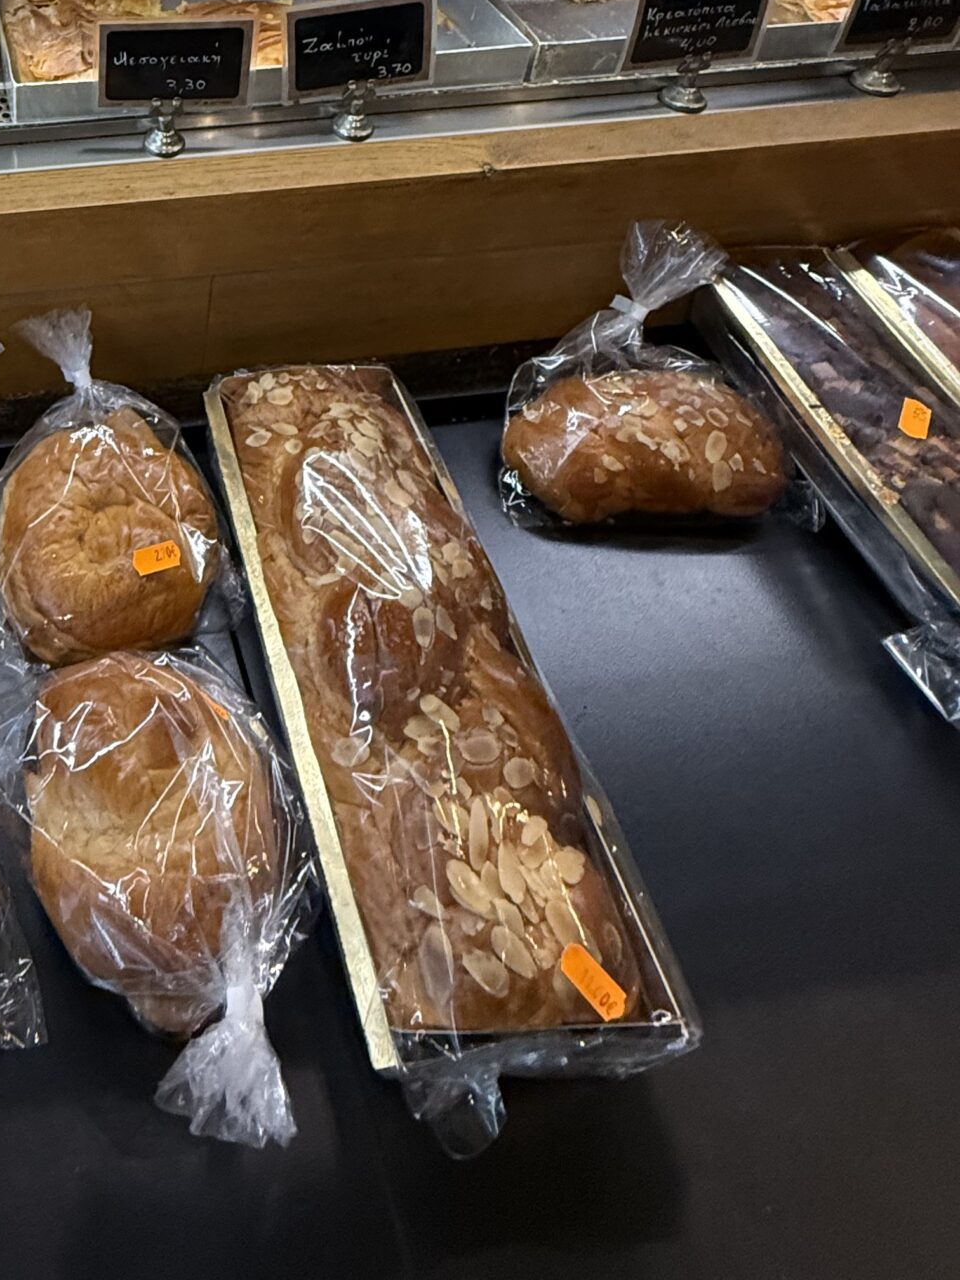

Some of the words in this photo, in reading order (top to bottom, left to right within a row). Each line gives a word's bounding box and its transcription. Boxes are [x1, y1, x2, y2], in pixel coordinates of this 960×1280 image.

[646, 1, 737, 27] Κρεατόπιτα
[113, 41, 221, 70] Μεσογειακή
[351, 37, 390, 68] τυρί
[377, 62, 412, 78] 3,70
